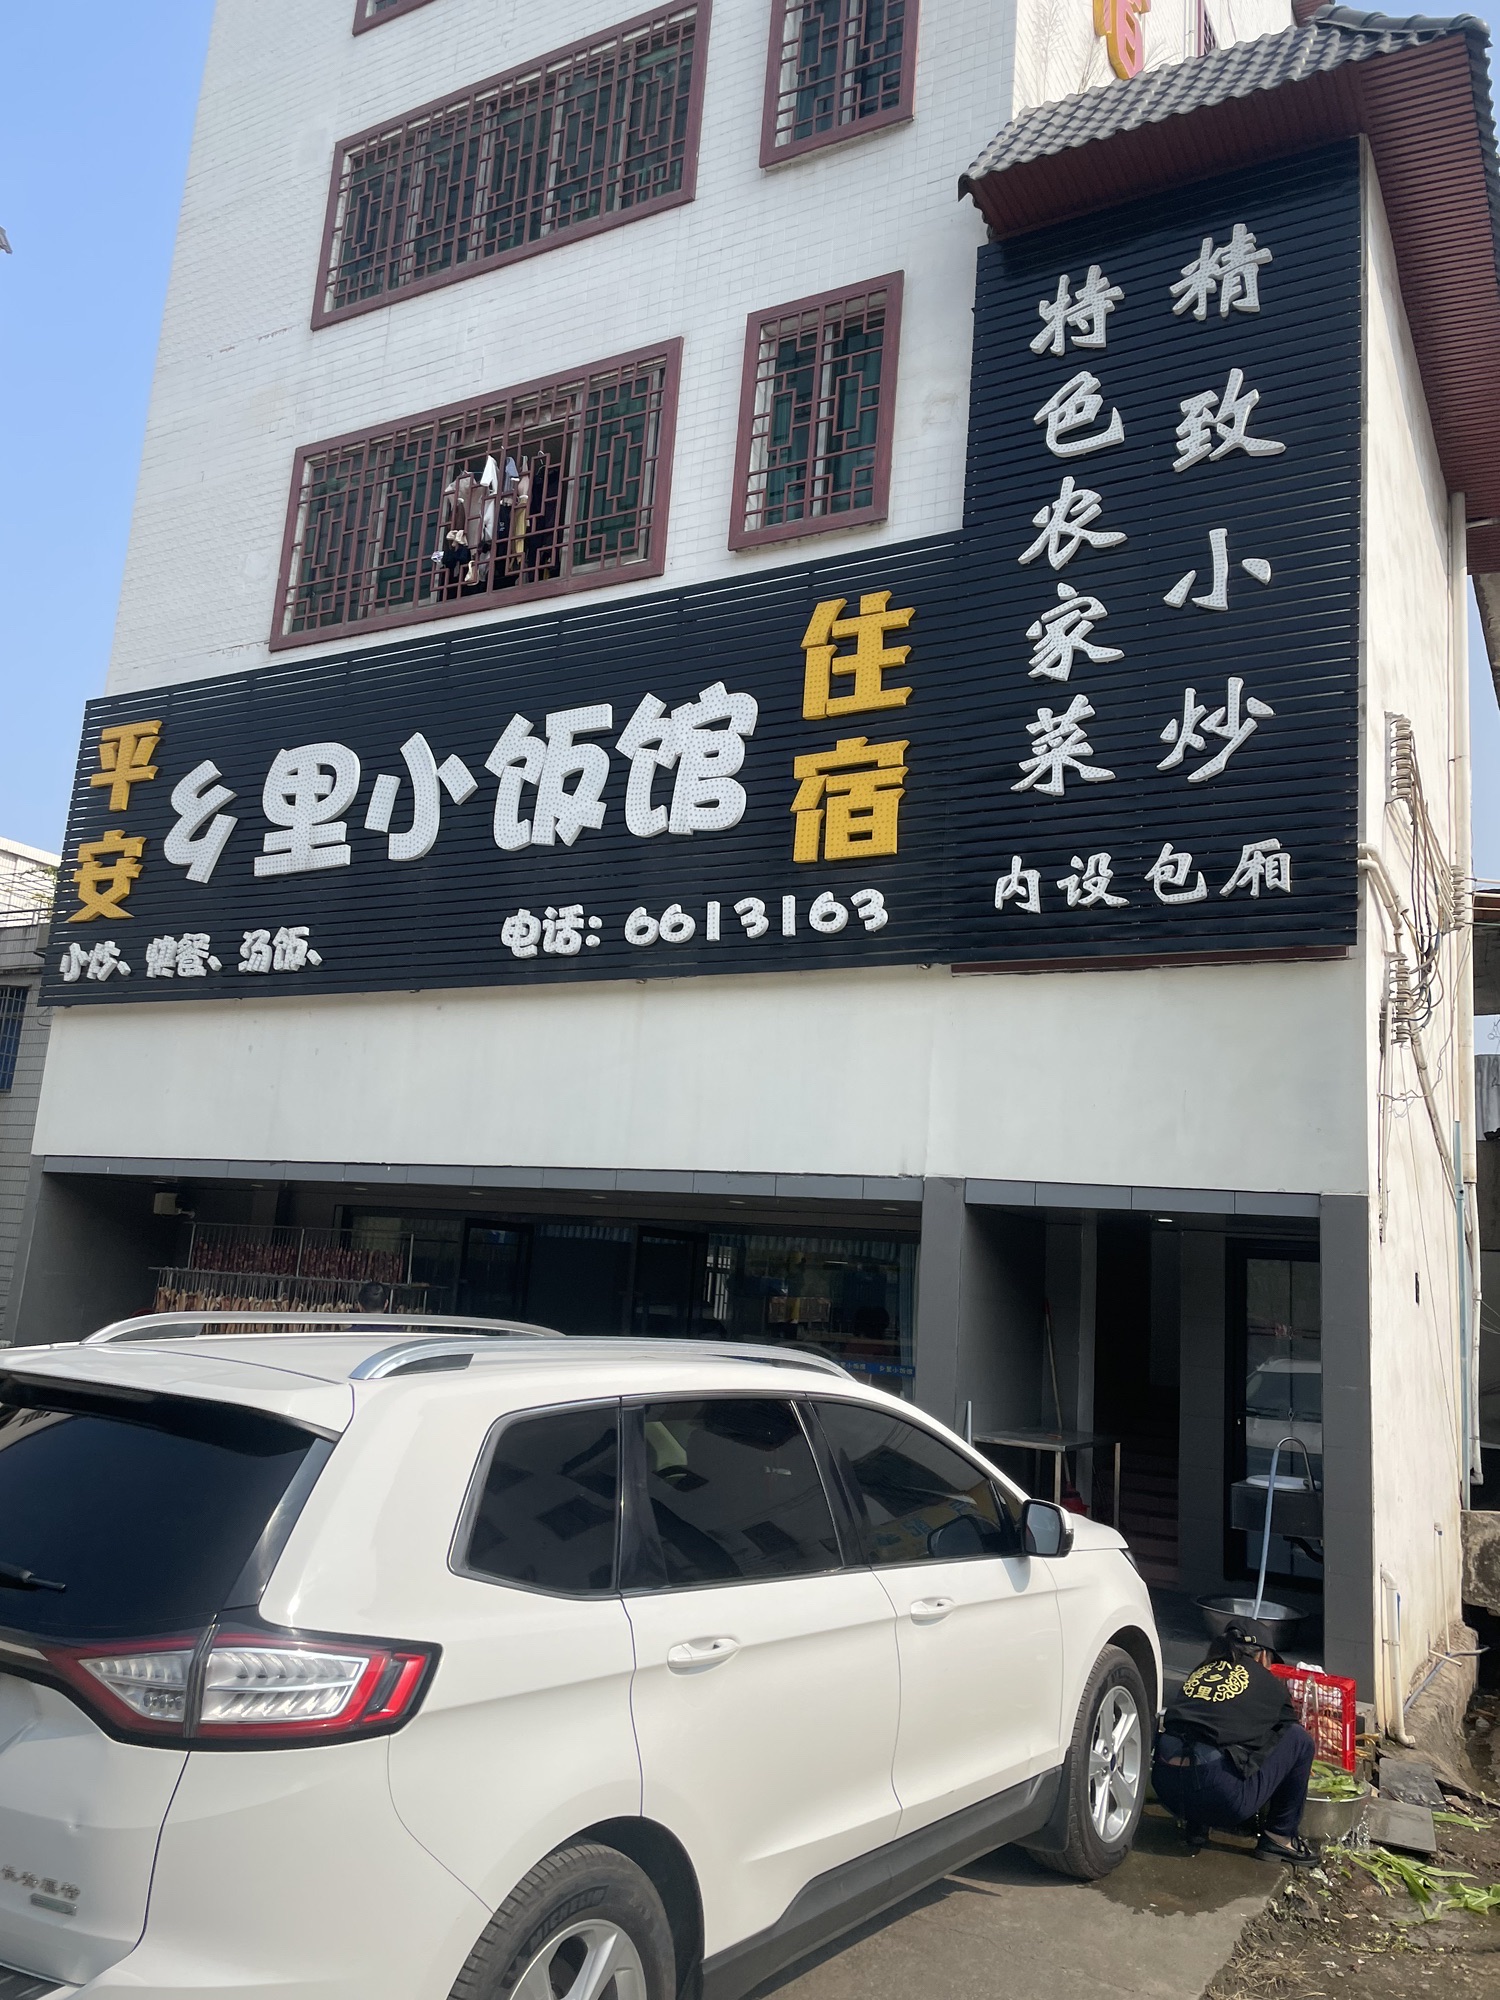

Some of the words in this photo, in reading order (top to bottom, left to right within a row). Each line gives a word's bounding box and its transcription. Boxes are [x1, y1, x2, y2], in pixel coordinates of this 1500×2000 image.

[1010, 264, 1129, 796] 特色农家菜
[1156, 223, 1287, 784] 精致小炒
[66, 719, 164, 923] 平安
[163, 681, 760, 884] 乡里小饭馆
[790, 590, 917, 864] 住宿
[994, 838, 1293, 915] 内设包厢
